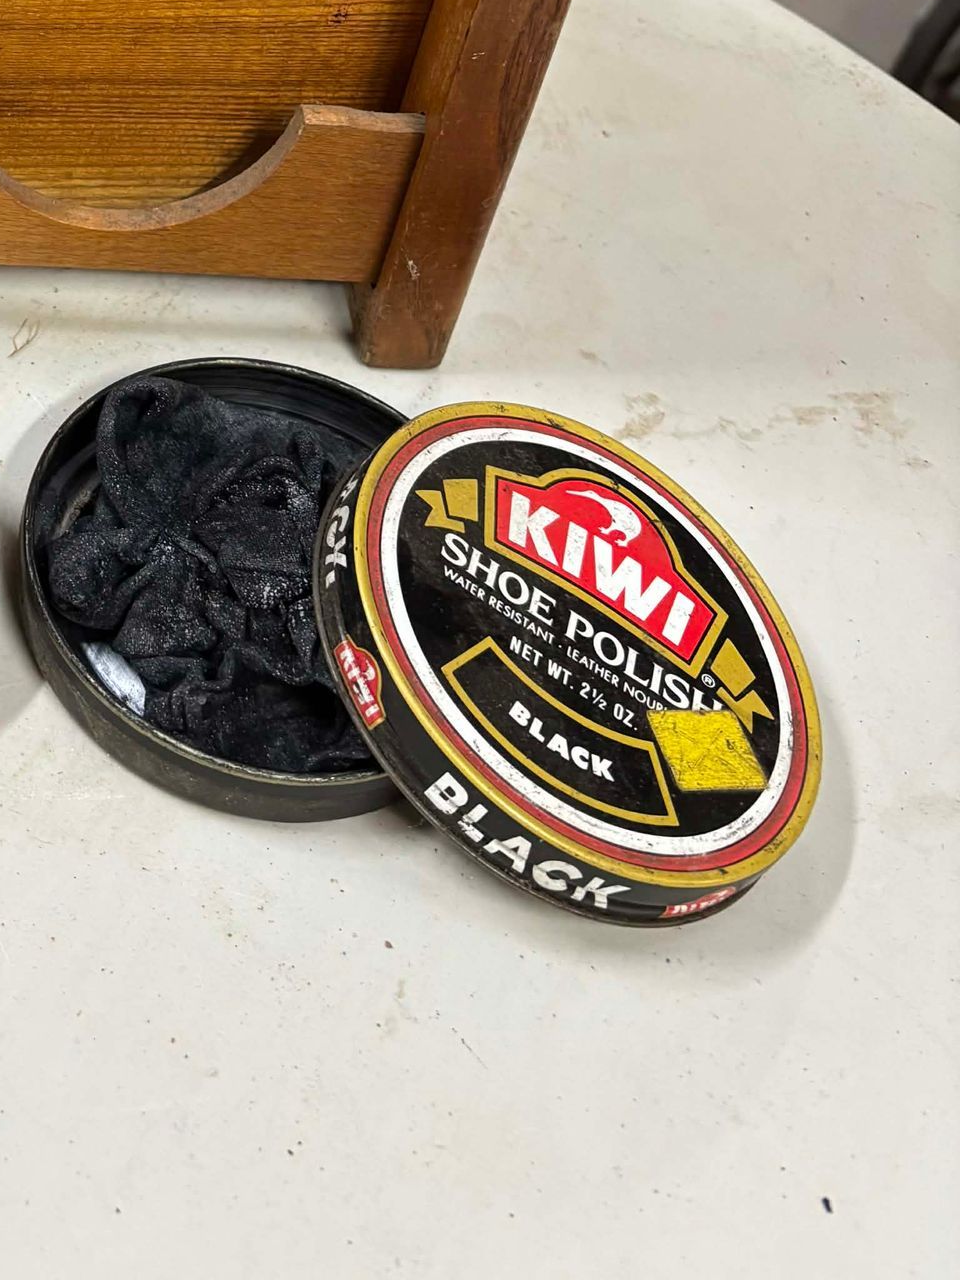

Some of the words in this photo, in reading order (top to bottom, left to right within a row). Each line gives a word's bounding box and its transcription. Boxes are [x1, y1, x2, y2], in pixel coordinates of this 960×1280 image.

[440, 532, 557, 627] SHOE
[508, 490, 696, 647] KIWI
[444, 565, 485, 601] WATER
[489, 596, 556, 649] RESISTANT
[566, 646, 620, 688] LEATHER
[509, 635, 544, 667] NET
[547, 659, 575, 690] WT.
[613, 702, 638, 731] OZ.
[508, 700, 615, 782] BLACK
[424, 771, 632, 909] BLACK
